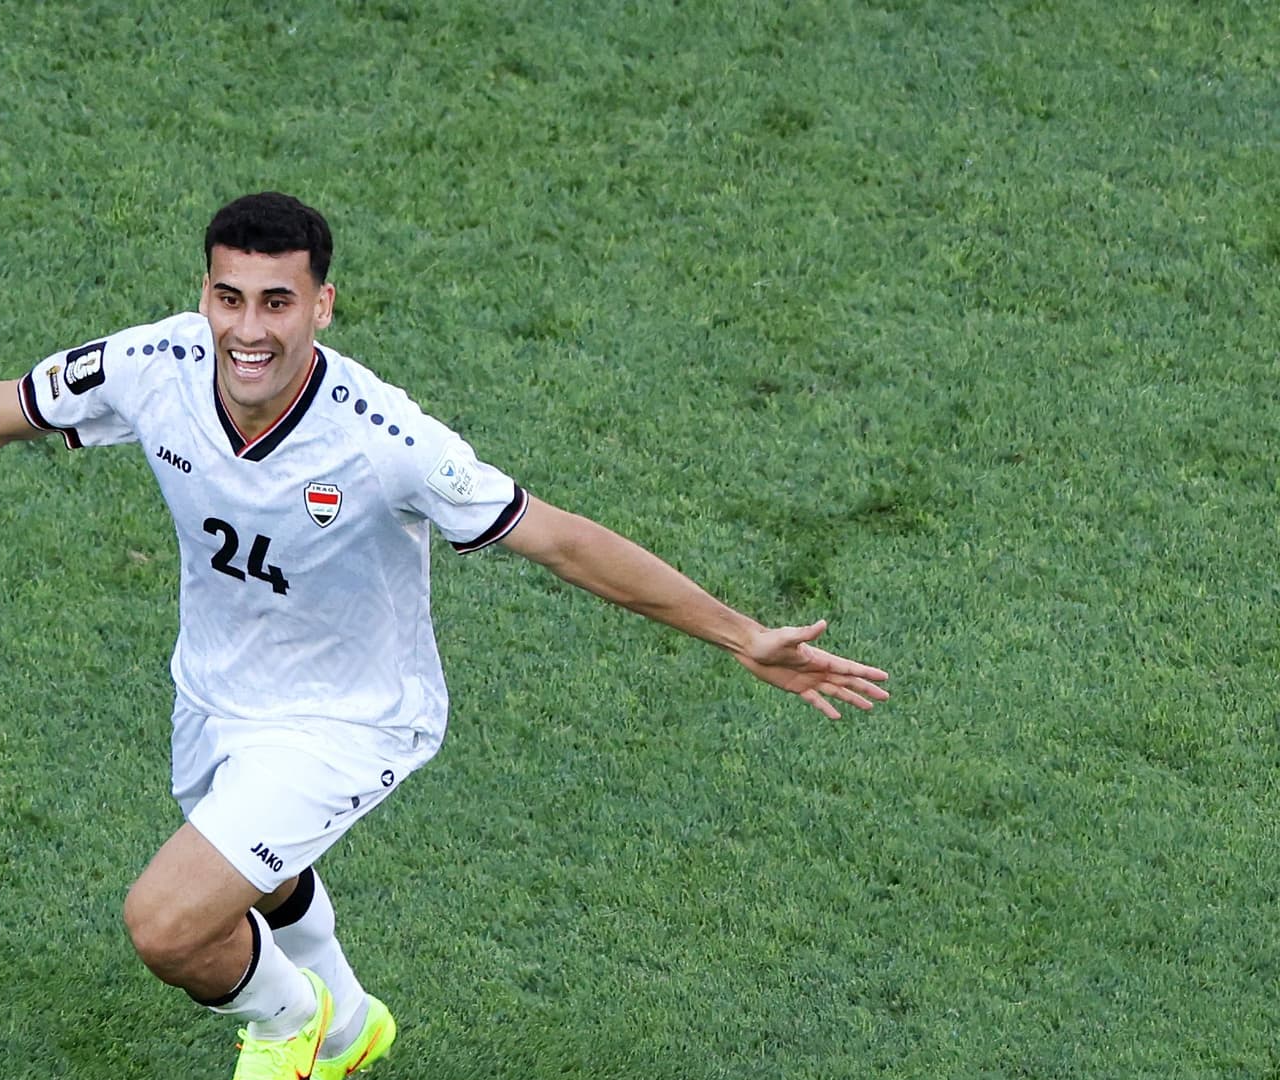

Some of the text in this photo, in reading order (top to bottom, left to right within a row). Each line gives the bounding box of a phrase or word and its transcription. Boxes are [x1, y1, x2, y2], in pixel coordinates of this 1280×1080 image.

[156, 445, 192, 474] JAKO
[203, 518, 289, 596] 24
[250, 842, 284, 873] JAKO
